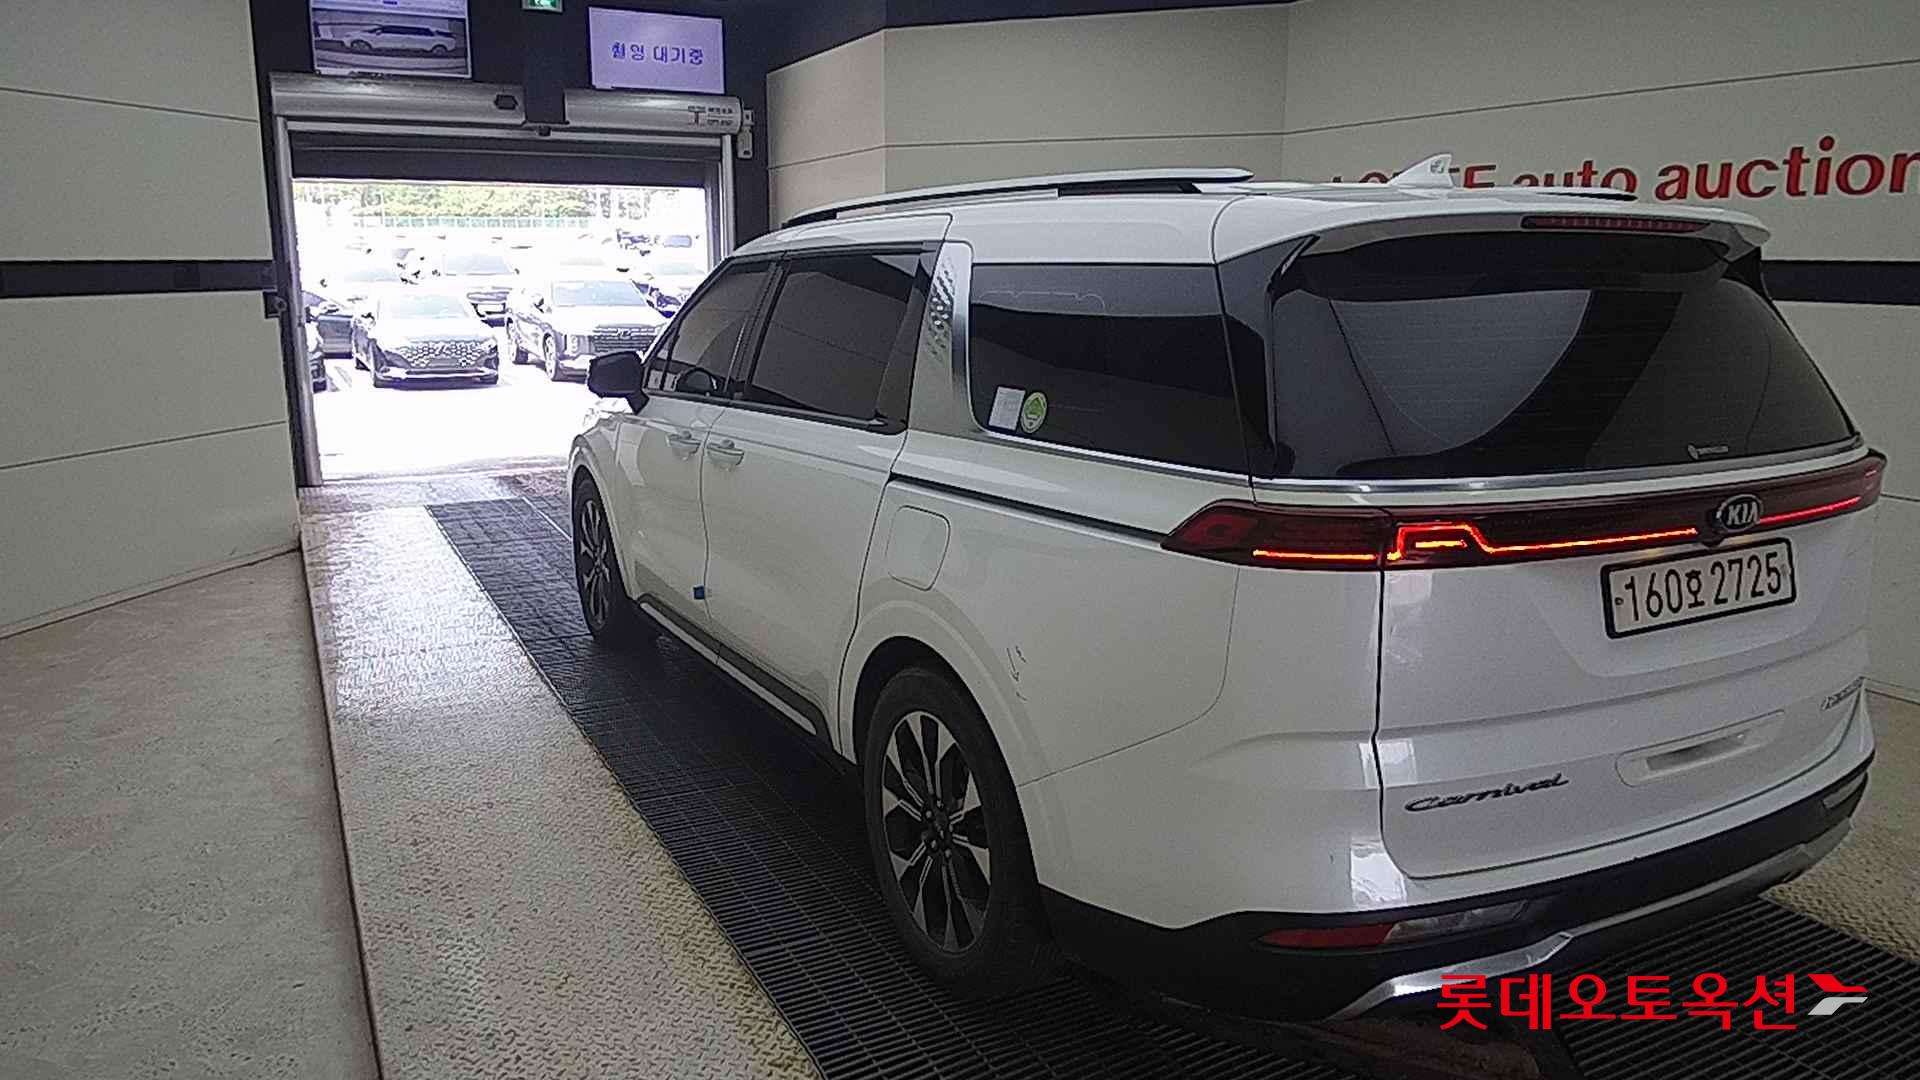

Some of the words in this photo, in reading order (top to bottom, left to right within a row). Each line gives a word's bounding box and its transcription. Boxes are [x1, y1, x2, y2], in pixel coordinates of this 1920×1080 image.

[1655, 135, 1920, 201] auction
[1727, 502, 1761, 526] KIA
[1405, 773, 1569, 811] Carnival
